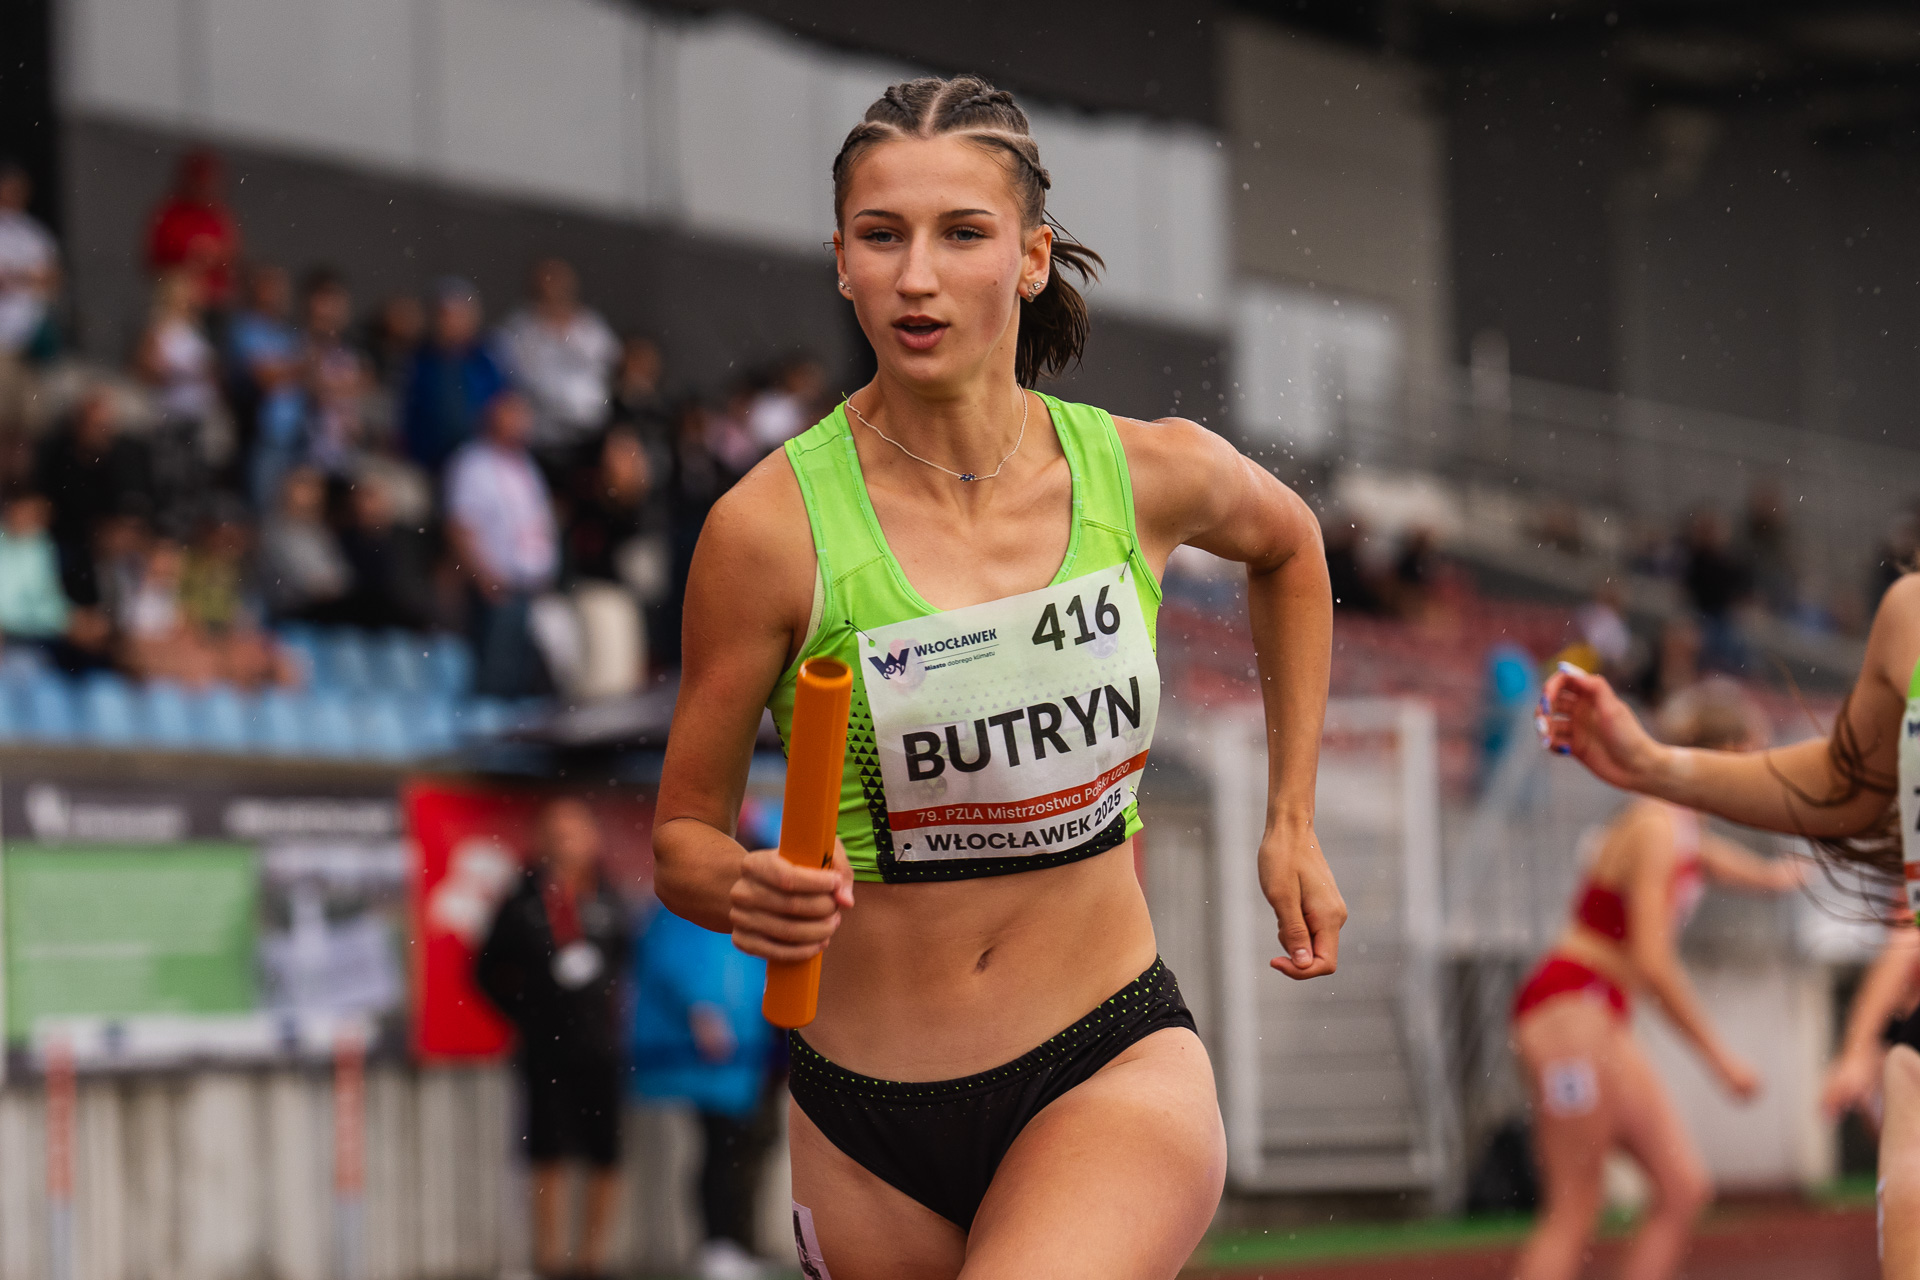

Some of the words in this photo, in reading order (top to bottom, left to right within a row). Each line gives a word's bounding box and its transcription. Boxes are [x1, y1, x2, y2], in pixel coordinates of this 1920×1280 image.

[914, 628, 998, 657] WŁOCŁAWEK
[1031, 585, 1121, 651] 416
[924, 662, 947, 671] Miasto
[947, 656, 973, 667] dobrego
[973, 650, 996, 660] klimatu
[902, 676, 1141, 782] BUTRYN
[917, 810, 942, 823] 79.
[946, 808, 984, 820] PZLA
[988, 791, 1082, 819] Mistrzostwa
[1111, 762, 1131, 781] U20
[925, 815, 1091, 851] WŁOCŁAWEK
[1094, 787, 1122, 827] 2025
